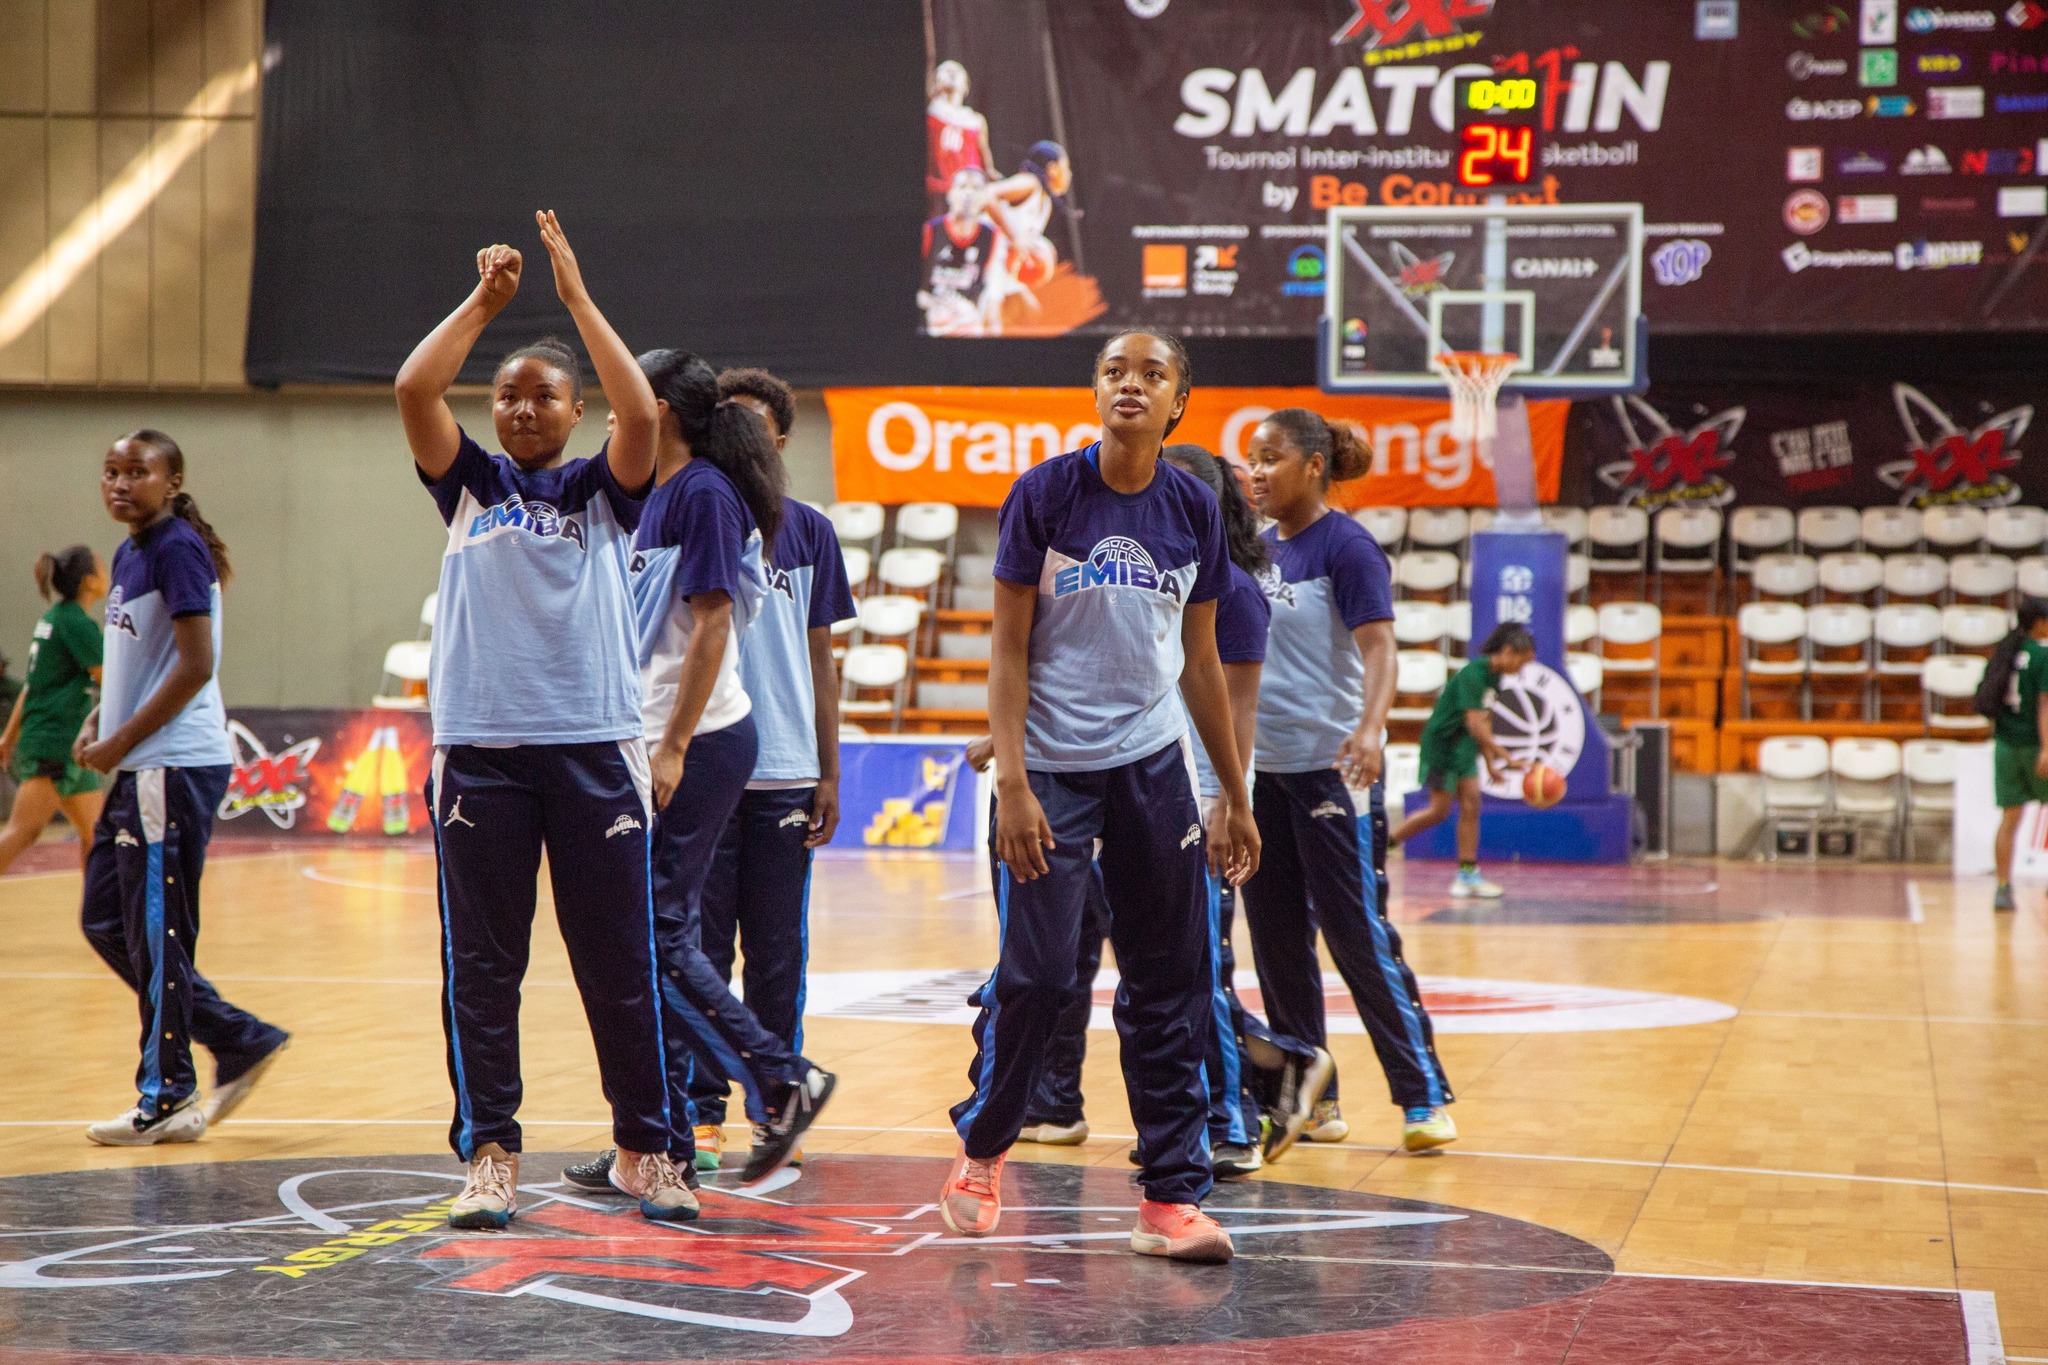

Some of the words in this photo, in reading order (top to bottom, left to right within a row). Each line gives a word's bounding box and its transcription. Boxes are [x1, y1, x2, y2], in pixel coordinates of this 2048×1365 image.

[1204, 145, 1297, 170] Tournoi
[1461, 123, 1532, 186] 24
[1262, 181, 1299, 211] by
[1310, 174, 1369, 208] Be
[1511, 256, 1599, 280] CANAL+
[1651, 239, 1713, 287] YOP
[867, 401, 1103, 476] Oran
[467, 503, 588, 554] EMIBA
[1053, 560, 1182, 606] EMIBA
[253, 1196, 459, 1279] NERGY
